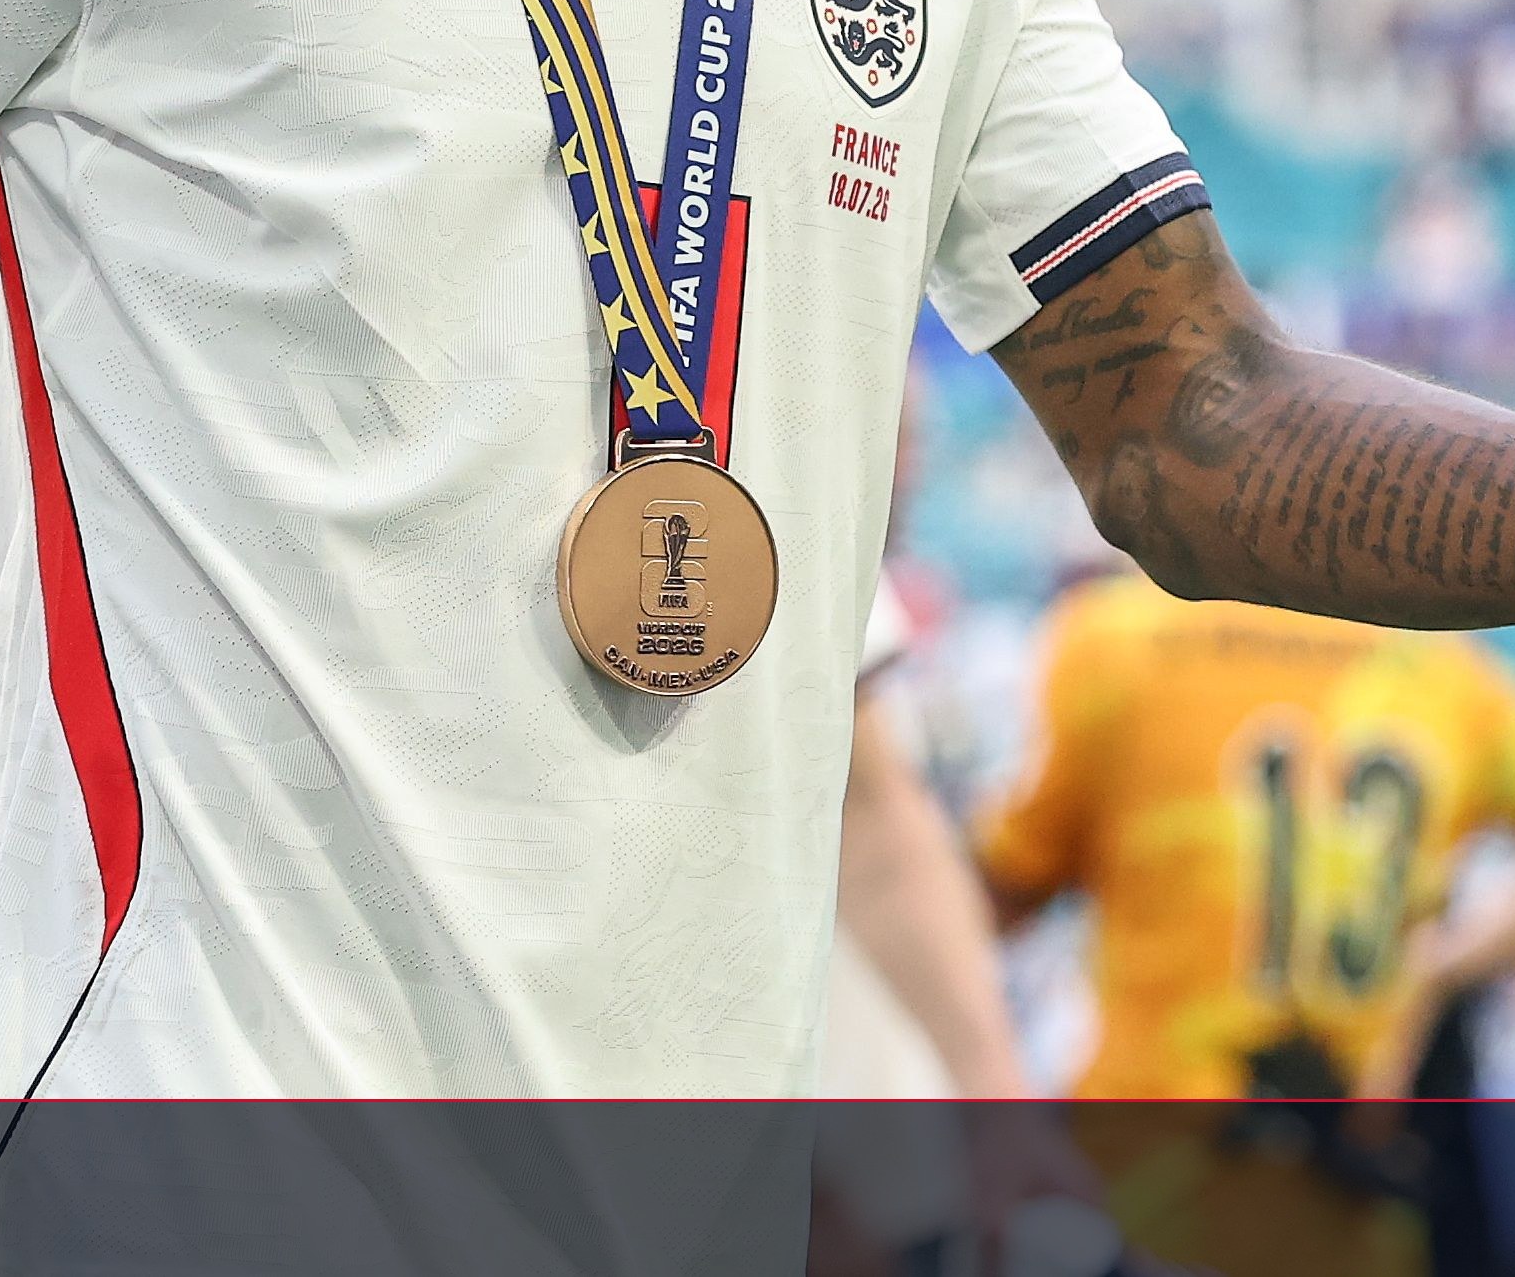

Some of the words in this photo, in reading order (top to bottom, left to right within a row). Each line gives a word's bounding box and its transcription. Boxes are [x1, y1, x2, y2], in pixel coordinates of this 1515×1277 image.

[695, 15, 731, 104] CUP
[831, 123, 901, 178] FRANCE
[674, 109, 720, 265] WORLD
[828, 171, 890, 222] 18.07.26
[670, 275, 701, 368] IFA
[636, 635, 706, 656] 2026
